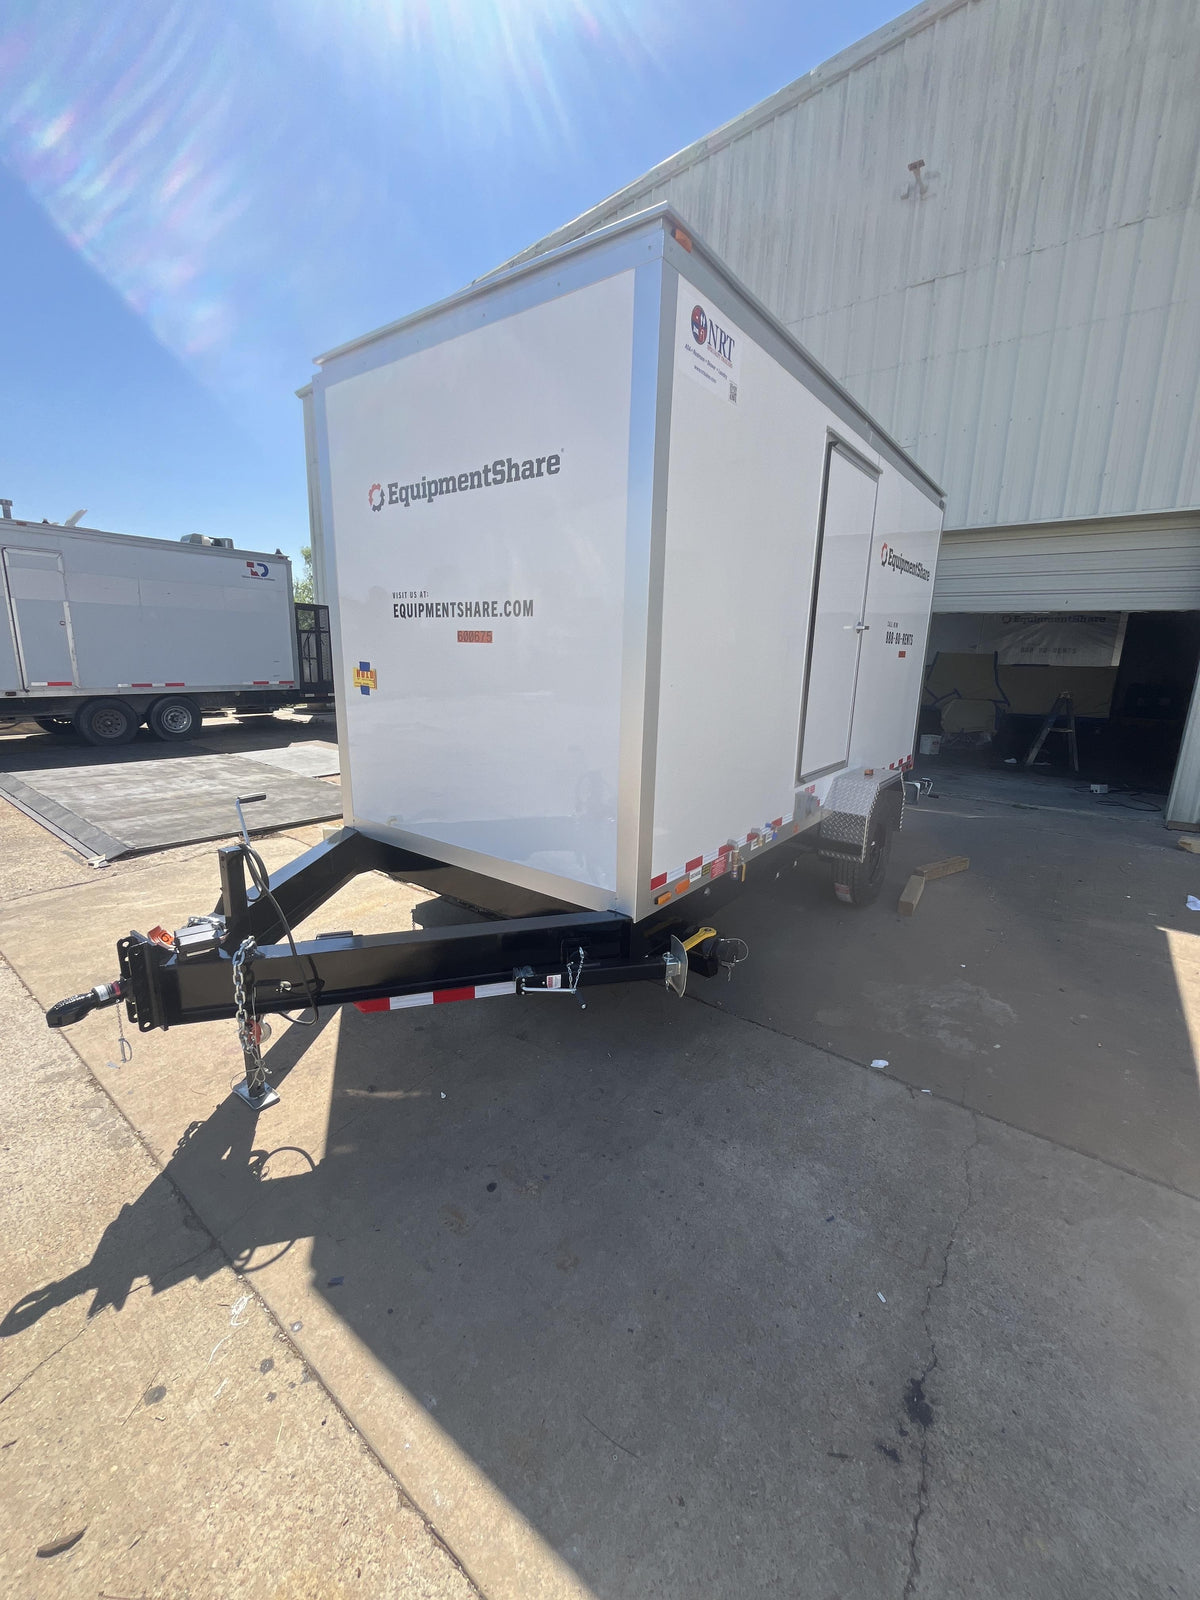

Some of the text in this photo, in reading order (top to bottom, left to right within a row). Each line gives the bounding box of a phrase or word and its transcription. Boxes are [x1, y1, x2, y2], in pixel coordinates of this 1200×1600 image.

[707, 318, 735, 362] NRT
[387, 453, 561, 507] EquipmentShare
[888, 547, 930, 581] EquipmentShare
[393, 599, 534, 619] EQUIPMENTSHARE.COM
[409, 591, 418, 599] US
